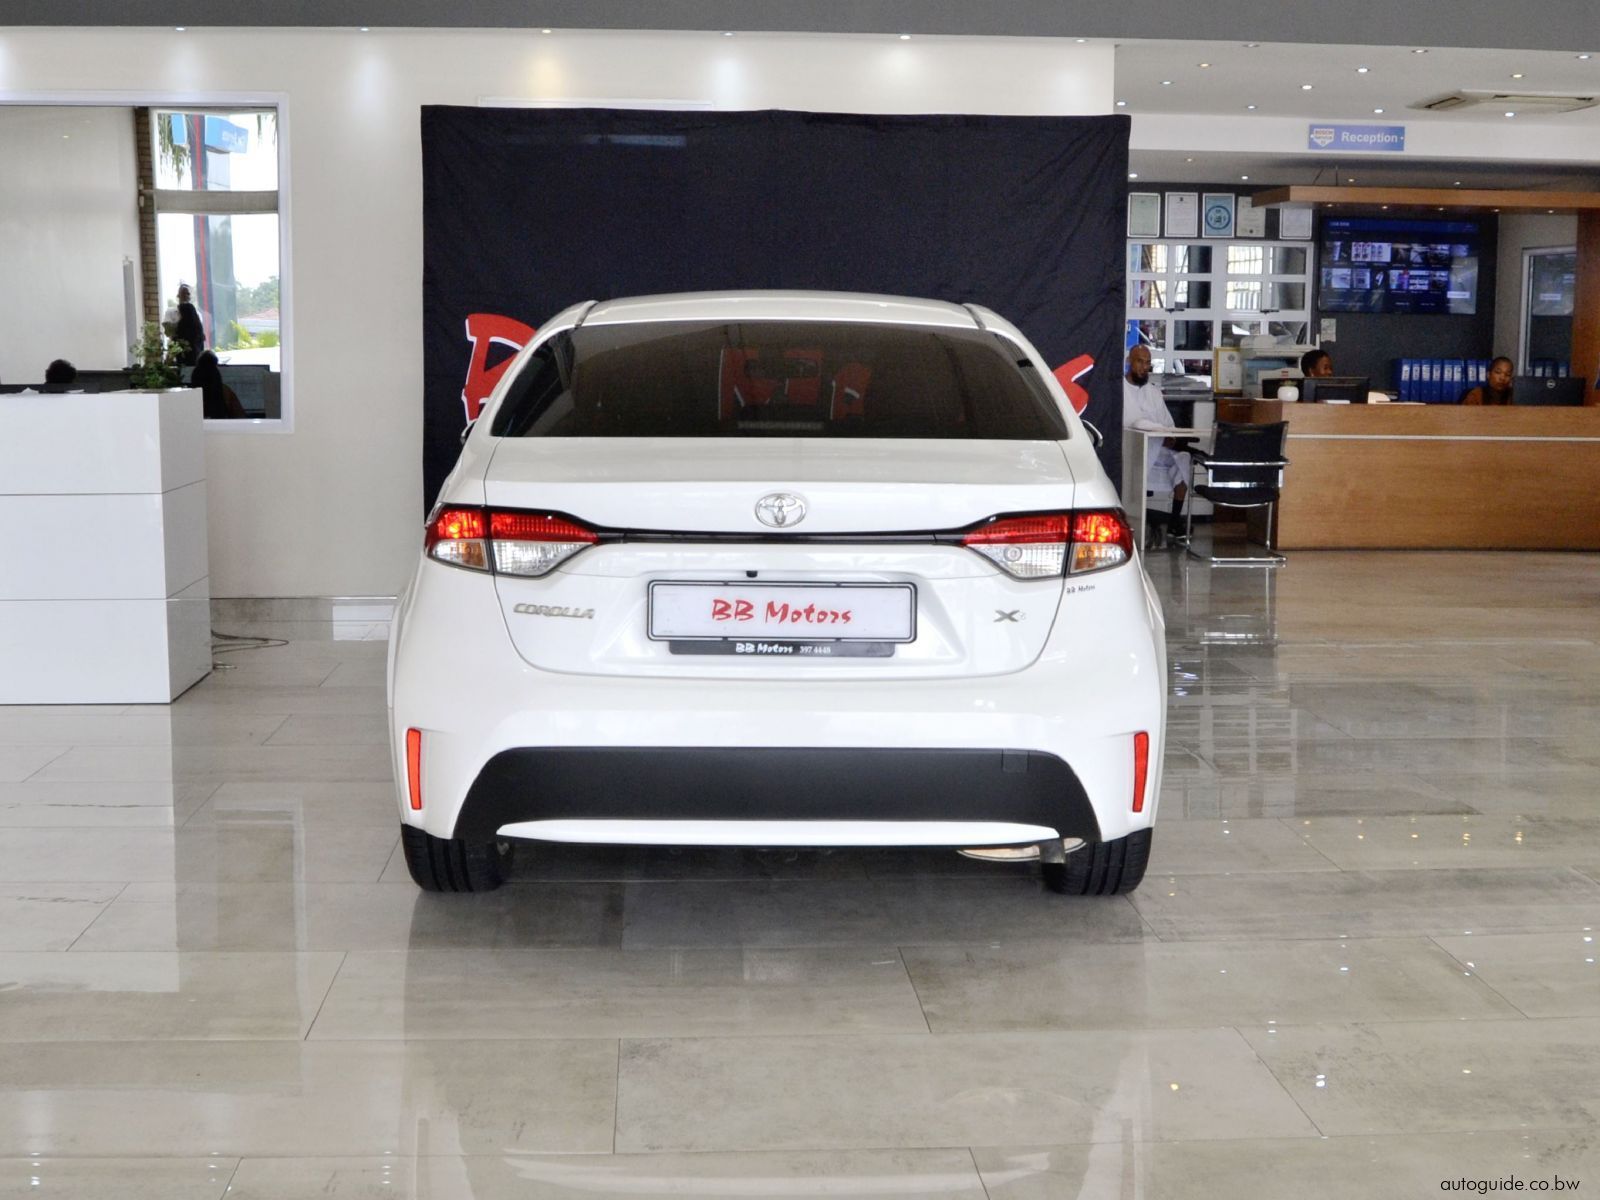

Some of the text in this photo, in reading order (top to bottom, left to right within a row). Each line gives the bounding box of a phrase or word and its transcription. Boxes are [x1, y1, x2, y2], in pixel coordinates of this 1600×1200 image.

[1341, 132, 1398, 144] Reception
[513, 603, 594, 619] COROLLA
[711, 599, 852, 624] BB Motors
[735, 642, 755, 653] BB
[757, 643, 794, 654] Motors
